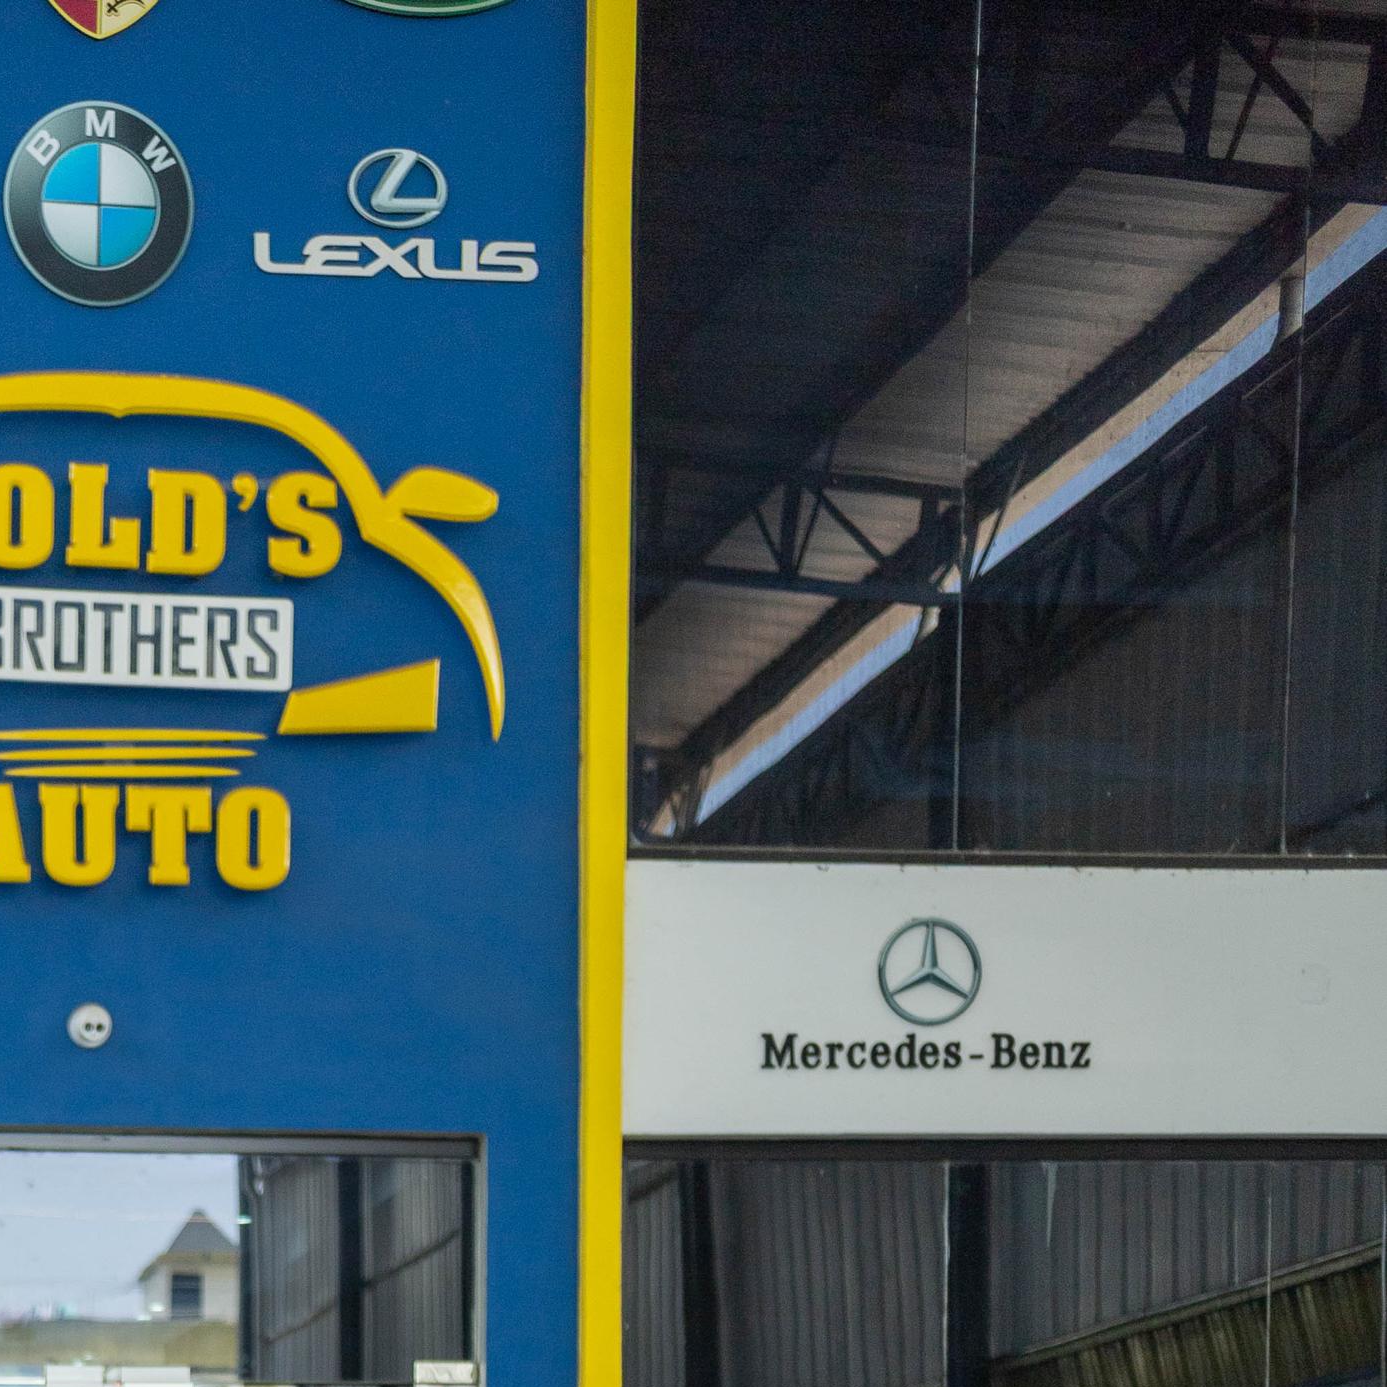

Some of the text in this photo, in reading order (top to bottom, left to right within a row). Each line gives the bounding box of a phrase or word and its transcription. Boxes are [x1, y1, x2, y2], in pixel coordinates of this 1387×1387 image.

[24, 110, 177, 175] BMW
[253, 231, 541, 283] LEXUS
[760, 1032, 1092, 1070] Mercedes-Benz
